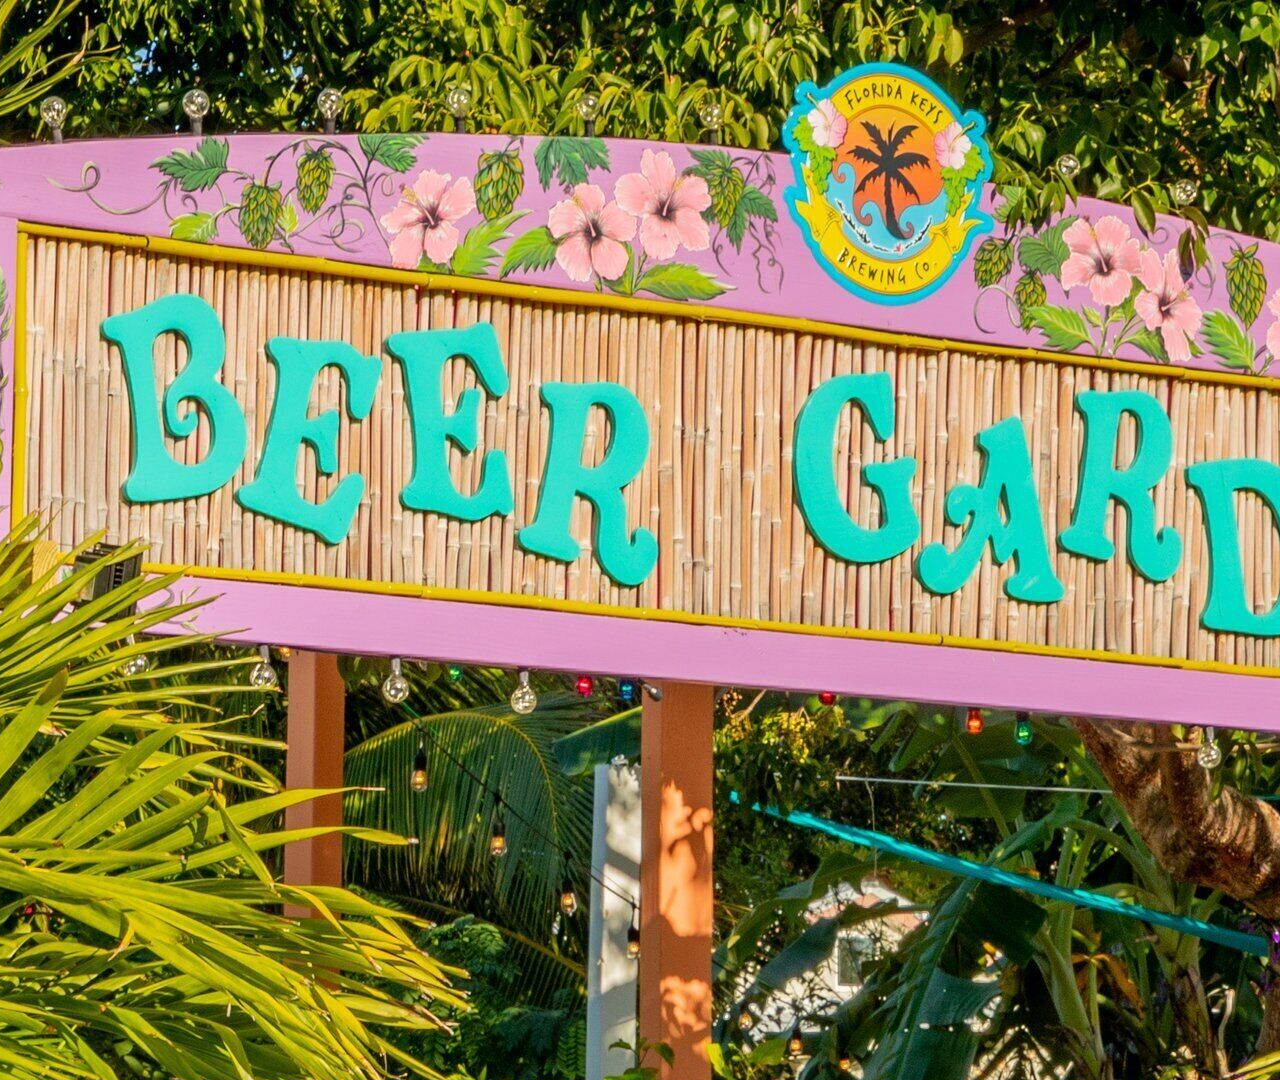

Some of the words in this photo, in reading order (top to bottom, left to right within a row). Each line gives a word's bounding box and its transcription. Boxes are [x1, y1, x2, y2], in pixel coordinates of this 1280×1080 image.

[844, 83, 903, 110] FLORIDA
[910, 91, 943, 124] KEYS
[838, 247, 906, 285] BREWING
[101, 293, 659, 586] BEER
